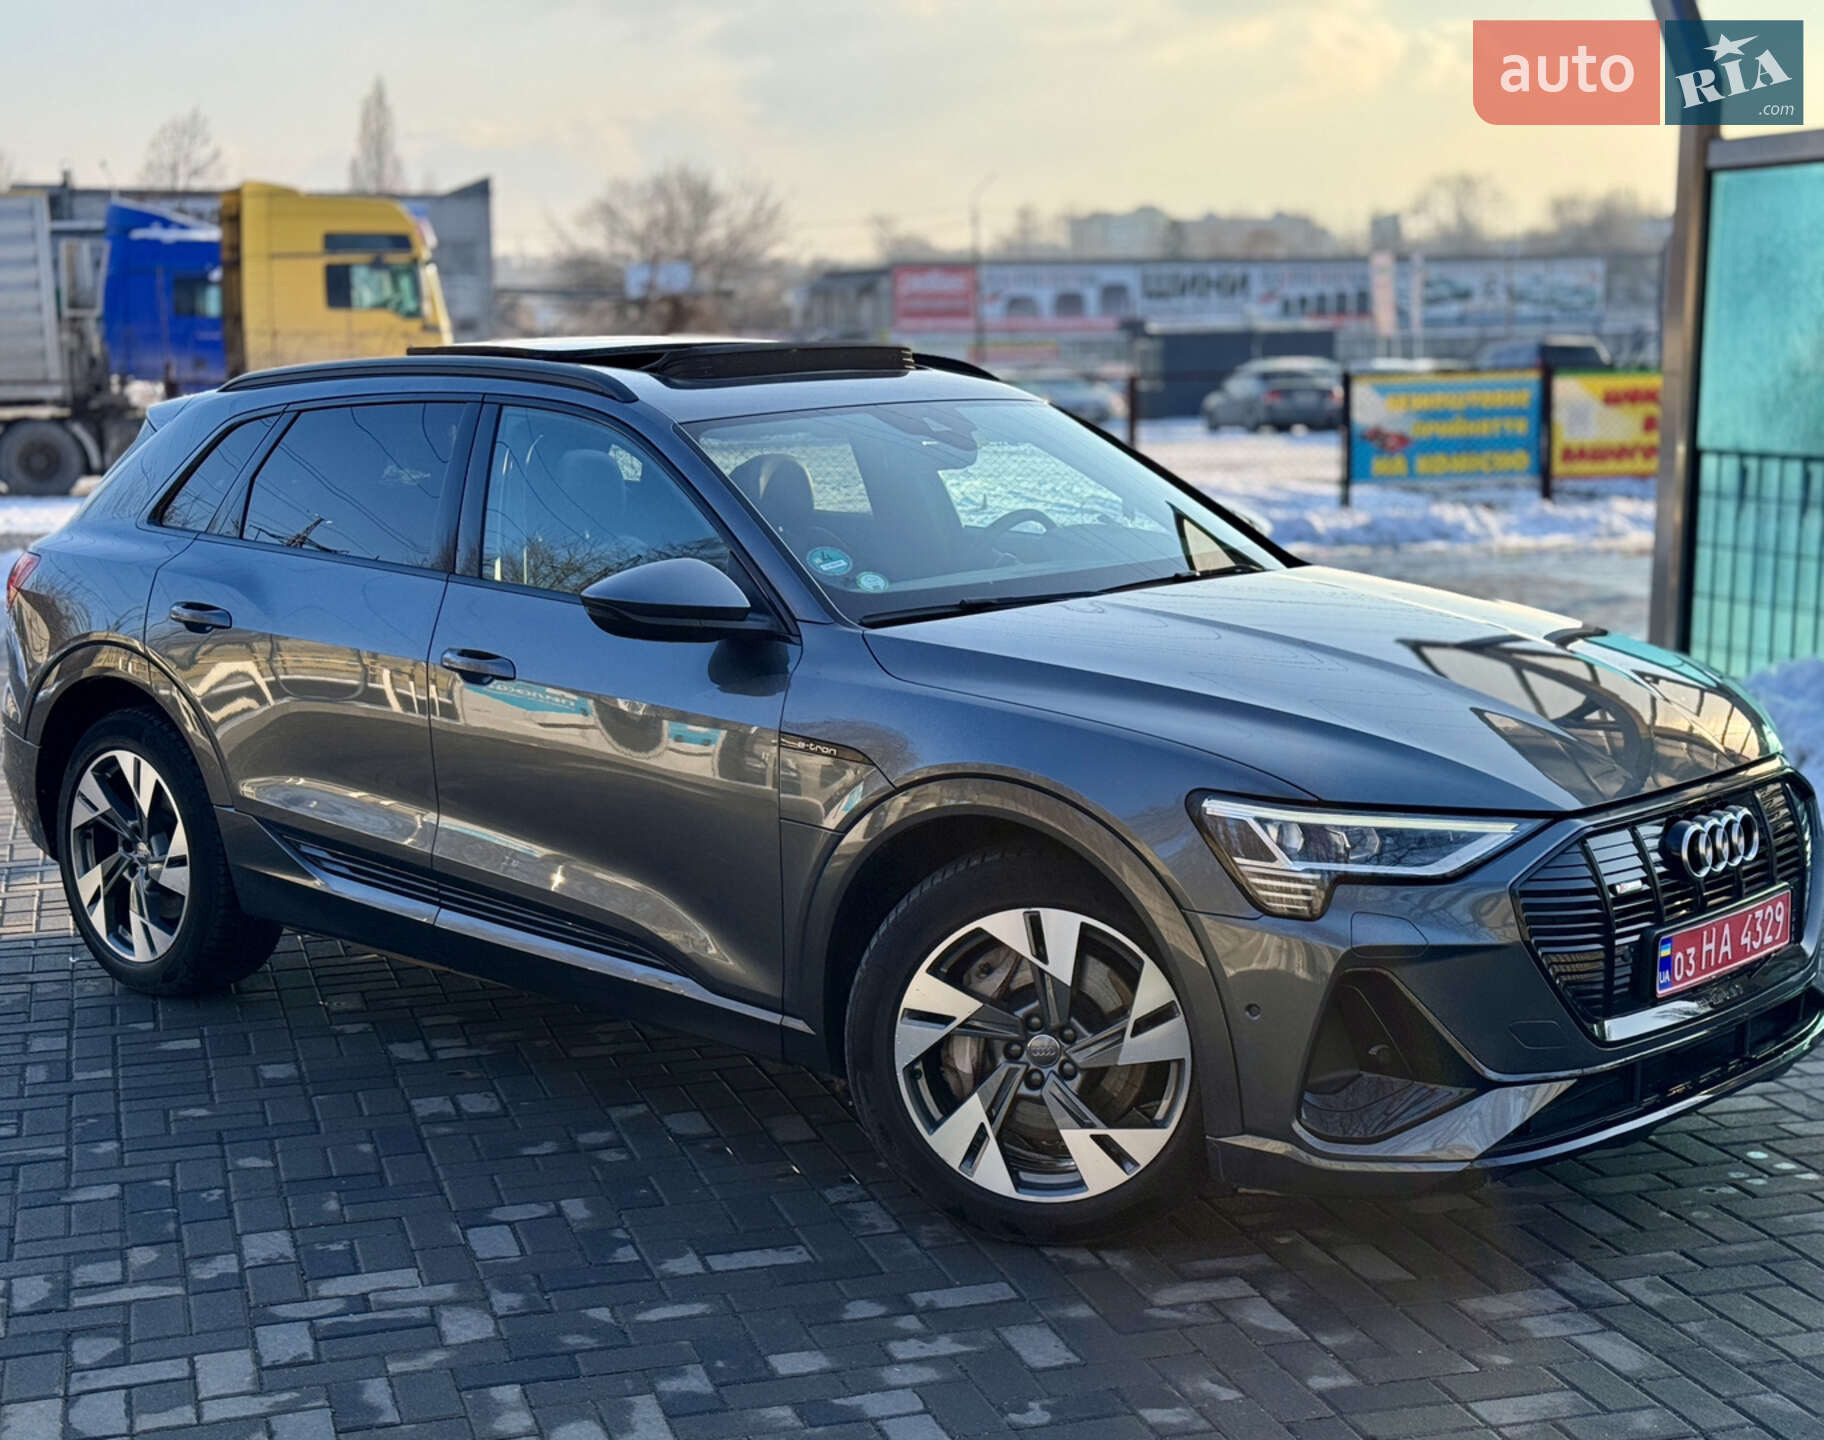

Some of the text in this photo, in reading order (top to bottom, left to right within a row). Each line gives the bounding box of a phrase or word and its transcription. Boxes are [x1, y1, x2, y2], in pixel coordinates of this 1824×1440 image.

[797, 740, 837, 757] e-tron
[1673, 901, 1785, 982] 03 HA 4329
[1659, 969, 1671, 985] UA
